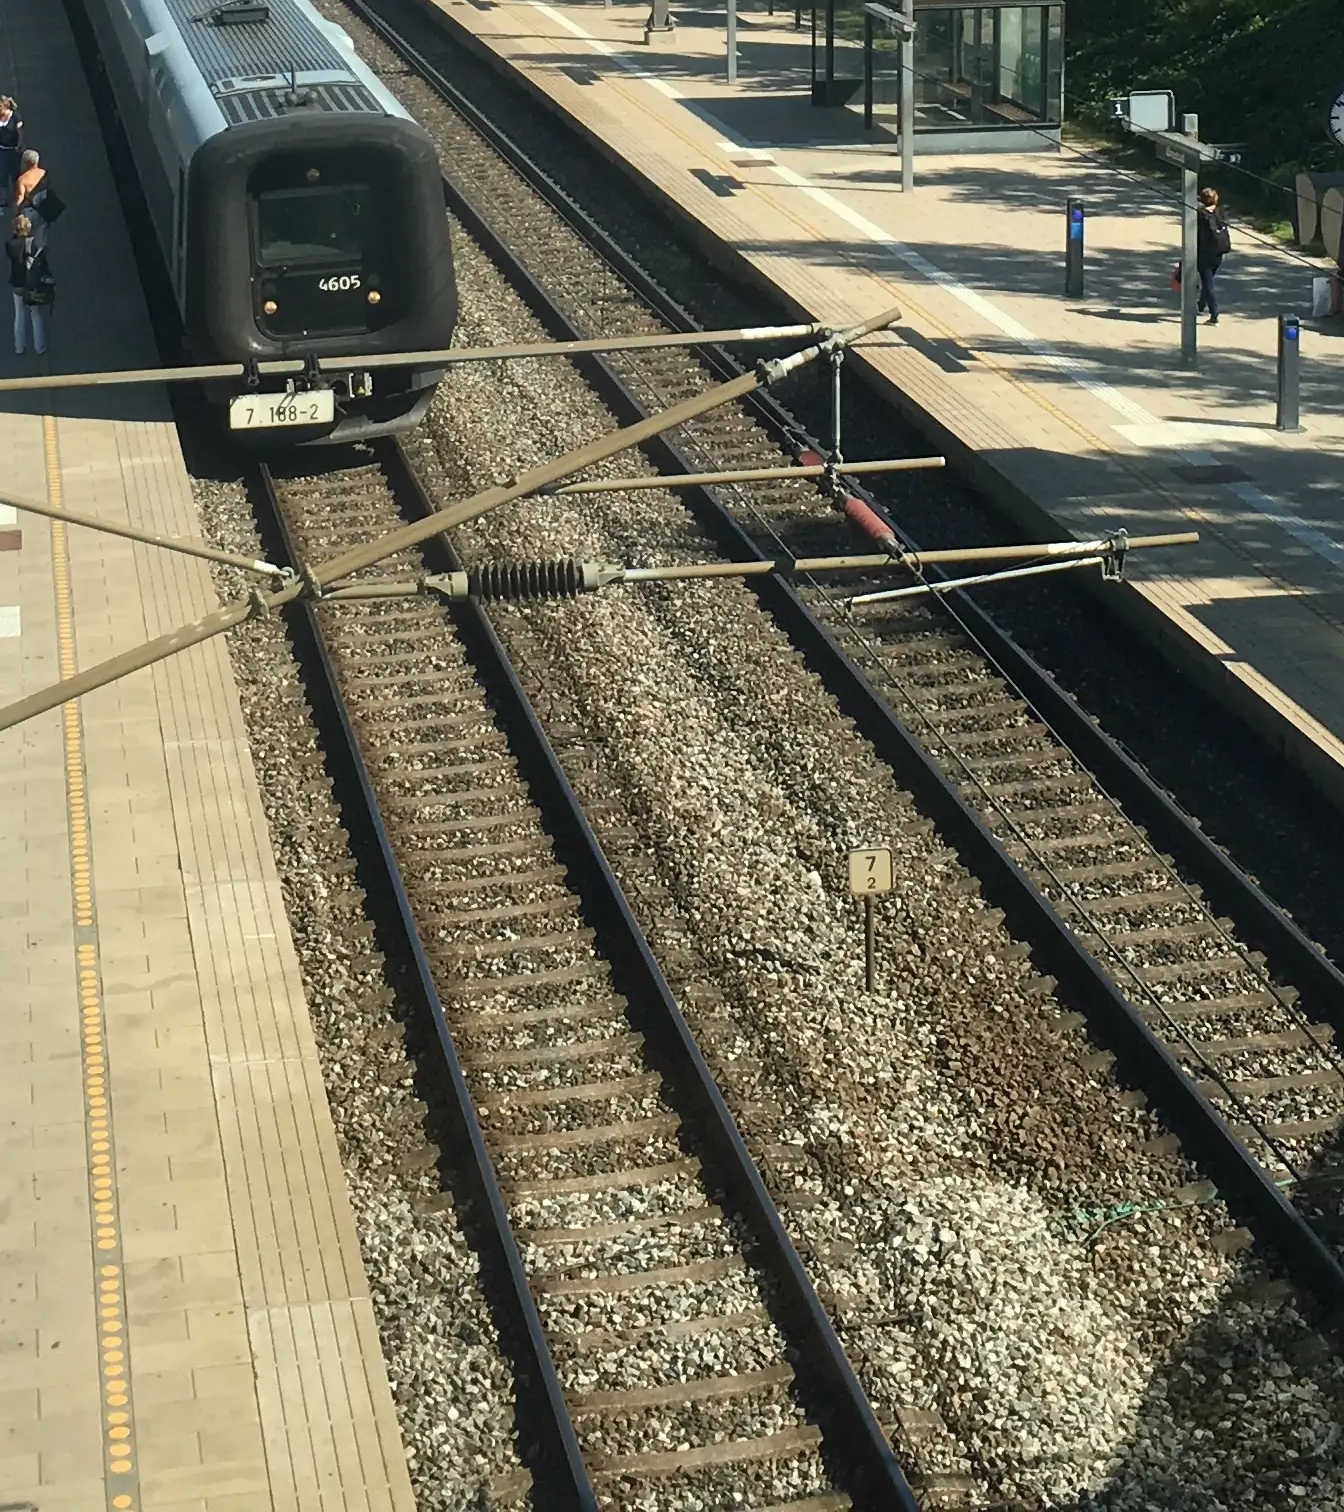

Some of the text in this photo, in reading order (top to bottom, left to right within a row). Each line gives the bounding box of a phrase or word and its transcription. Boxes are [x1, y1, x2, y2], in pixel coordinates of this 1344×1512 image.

[1114, 103, 1123, 115] 1
[318, 274, 361, 291] 4605
[865, 855, 876, 872] 7
[867, 876, 876, 890] 2
